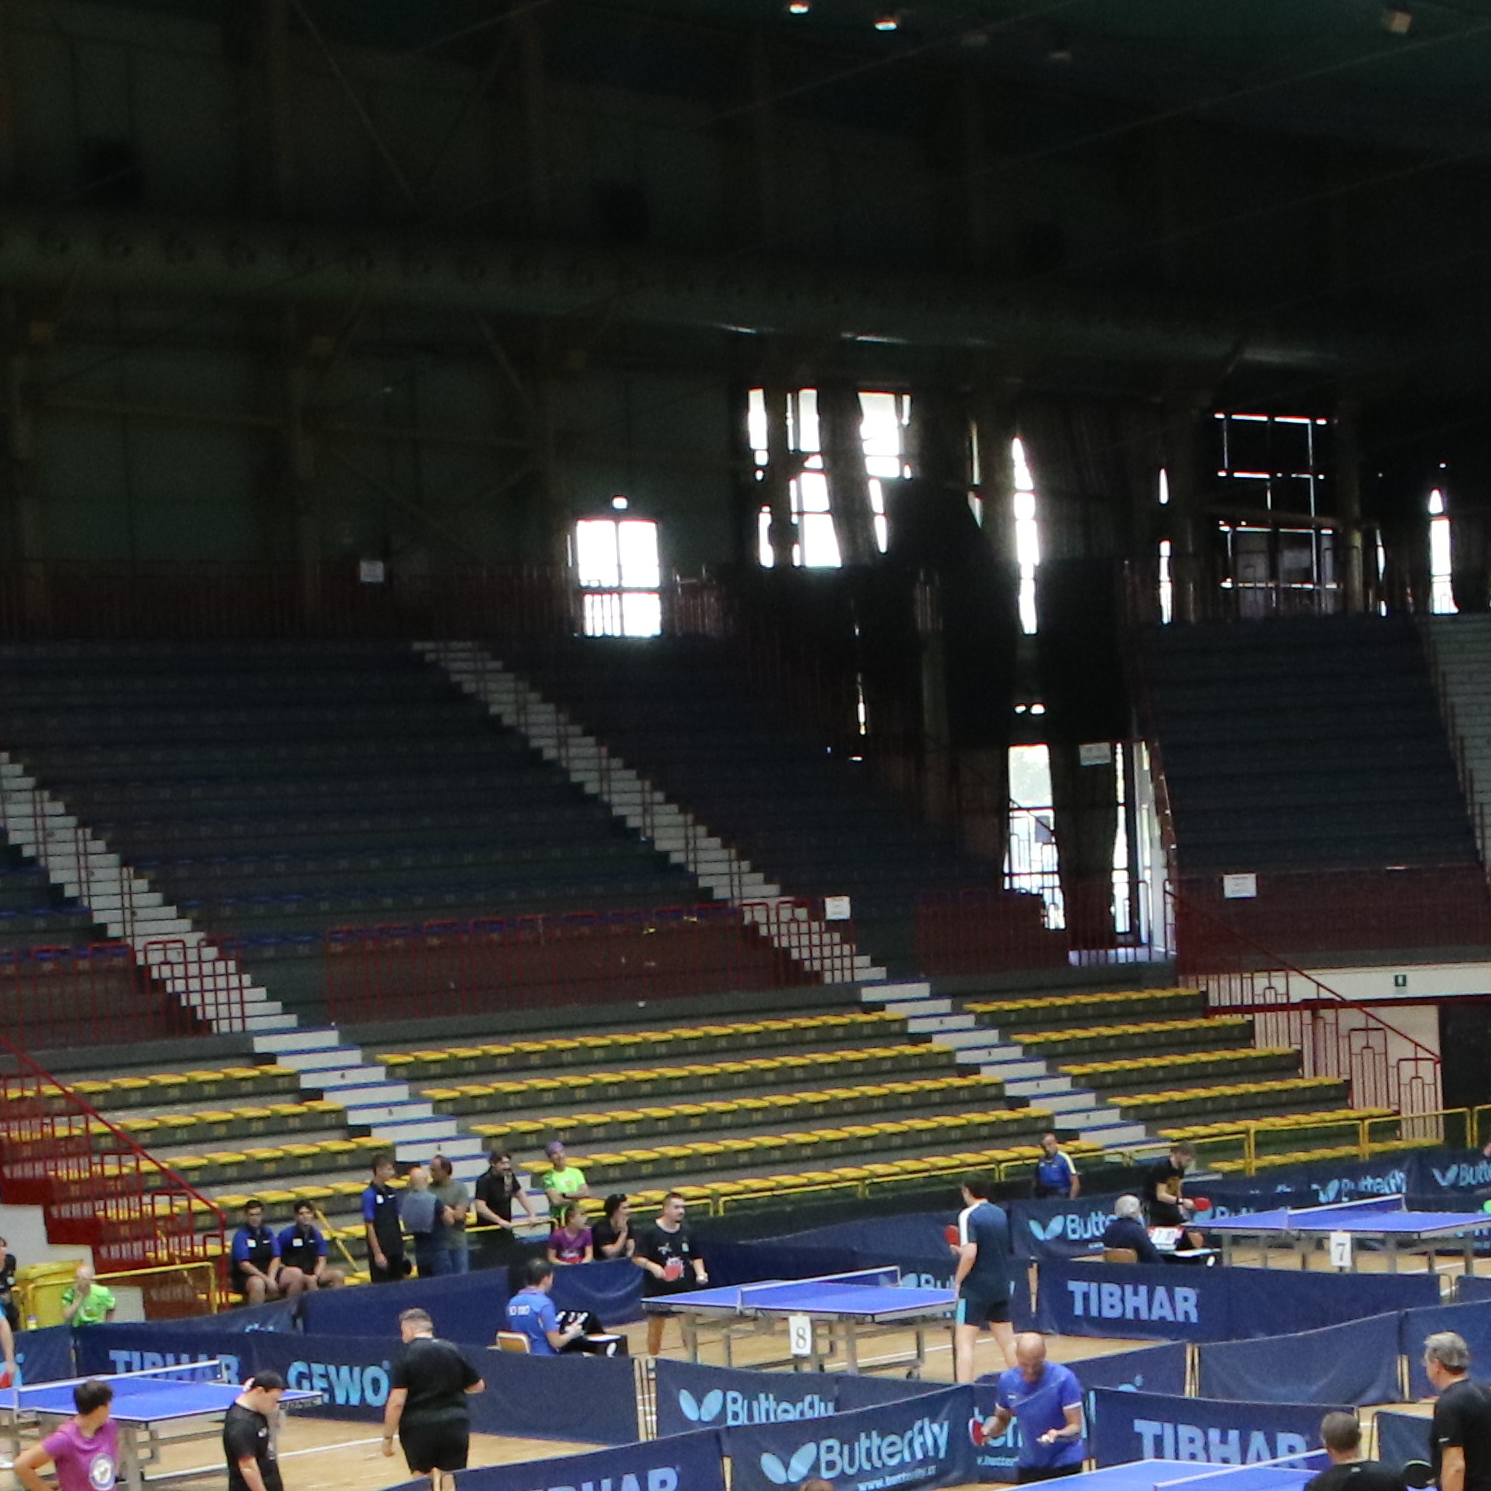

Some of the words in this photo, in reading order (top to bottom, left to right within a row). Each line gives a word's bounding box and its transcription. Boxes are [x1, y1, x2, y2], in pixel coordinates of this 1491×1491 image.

[1336, 1242, 1347, 1263] 7
[1066, 1280, 1200, 1324] TIBHAR
[795, 1326, 807, 1349] 8
[286, 1360, 390, 1408] GEWO
[725, 1390, 836, 1426] Butterfly
[818, 1418, 950, 1480] Butterfly
[1132, 1418, 1309, 1470] TIBHAR
